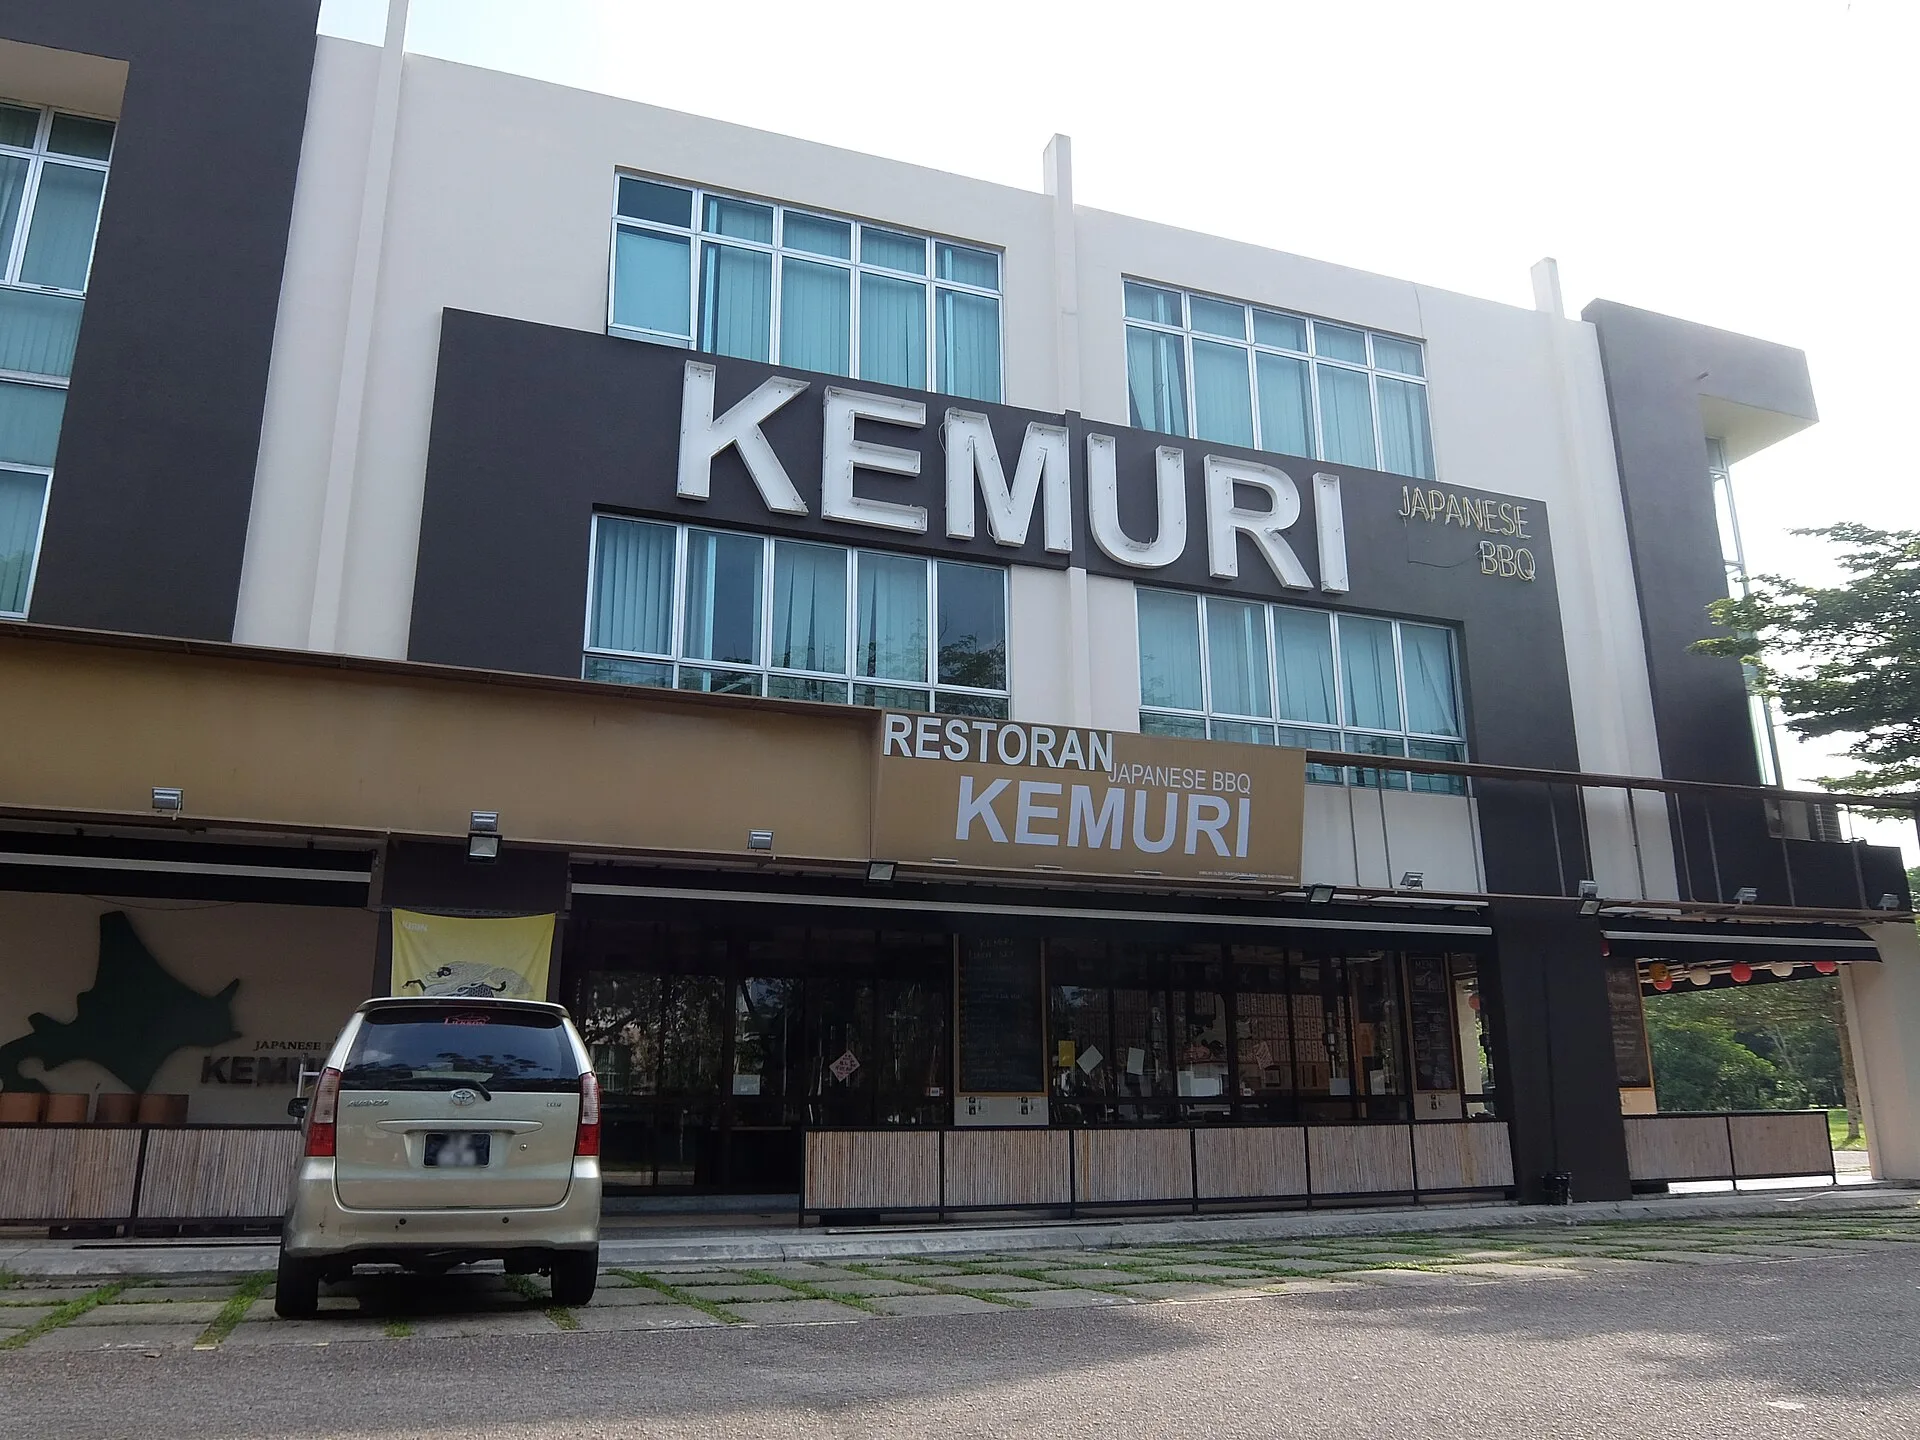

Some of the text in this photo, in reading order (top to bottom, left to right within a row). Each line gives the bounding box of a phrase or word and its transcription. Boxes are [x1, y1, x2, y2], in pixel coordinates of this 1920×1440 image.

[676, 360, 1349, 593] KEMURI
[1398, 485, 1531, 540] JAPANESE
[1479, 540, 1536, 582] BBQ
[883, 713, 1114, 772] RESTORAN
[1108, 762, 1251, 795] JAPANESE BBQ
[955, 776, 1251, 858] KEMURI
[253, 1041, 321, 1051] JAPANESE
